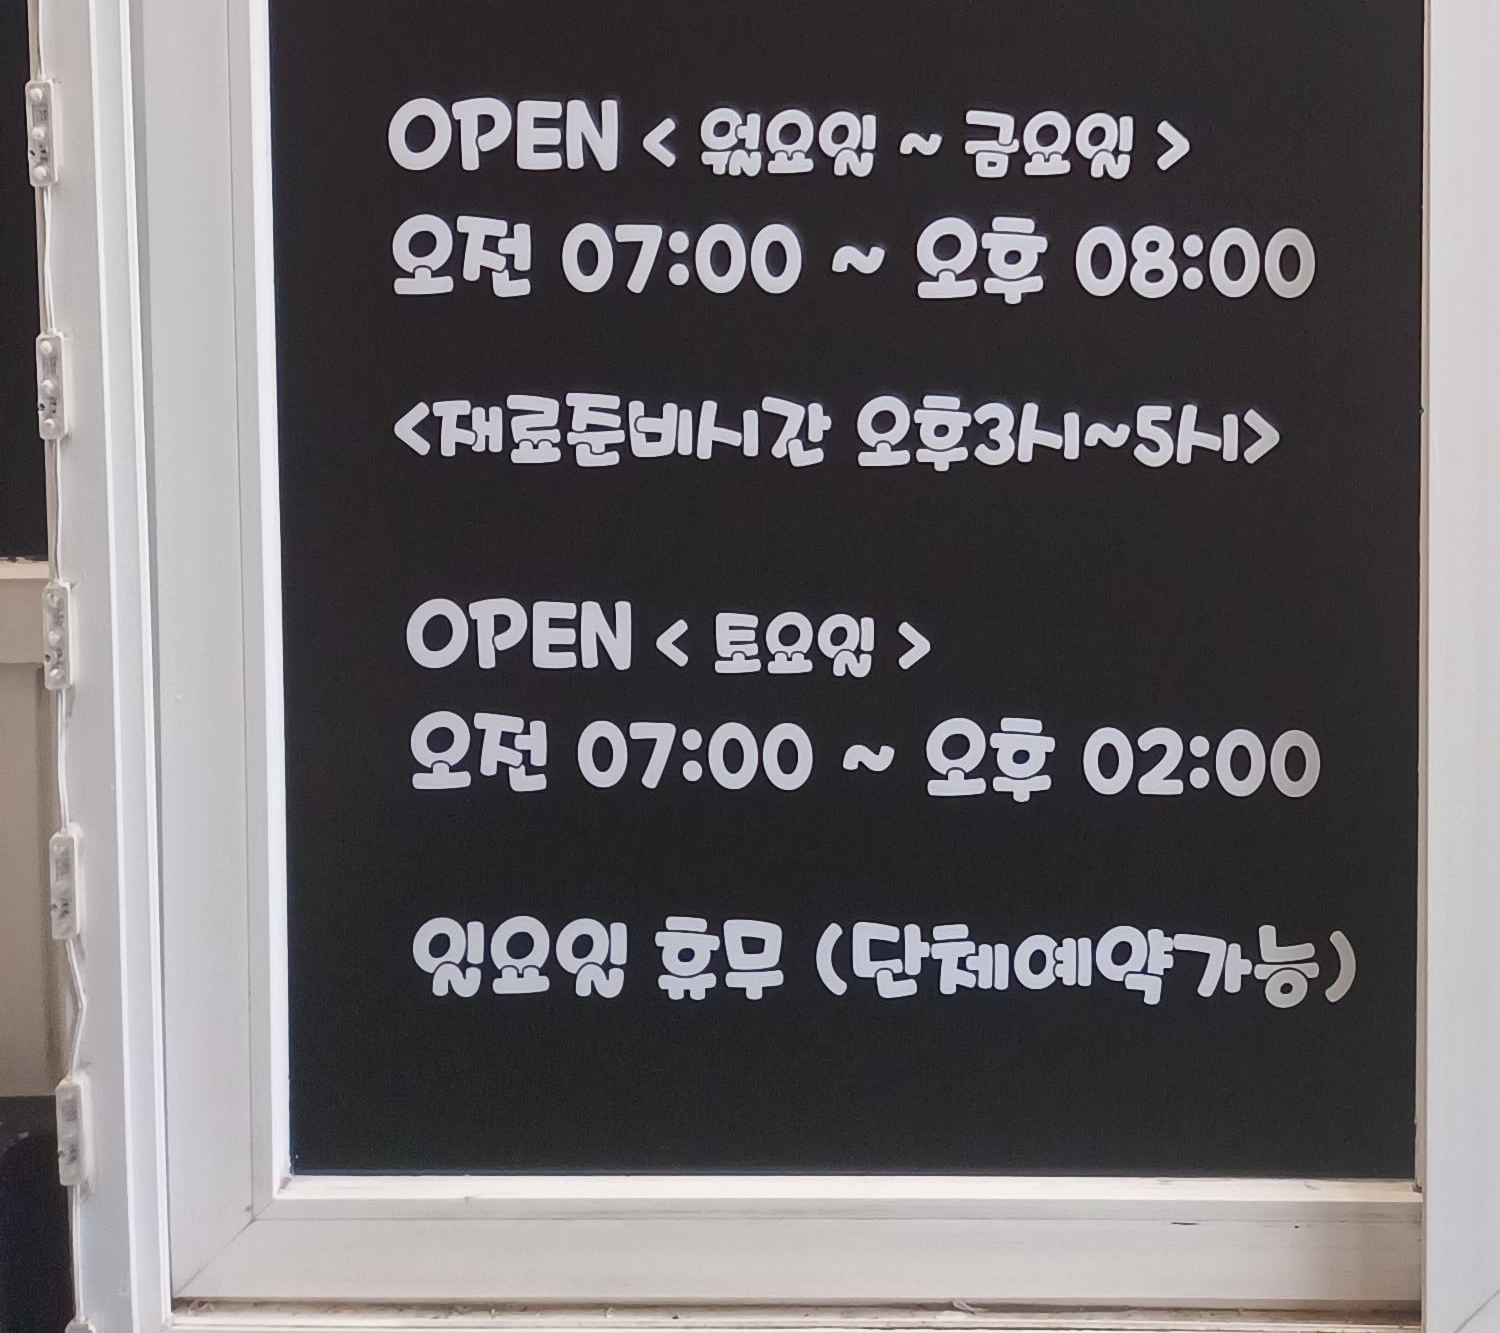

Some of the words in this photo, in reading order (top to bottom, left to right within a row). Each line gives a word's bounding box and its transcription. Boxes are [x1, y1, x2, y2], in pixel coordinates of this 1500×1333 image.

[388, 97, 620, 171] OPEN
[701, 108, 877, 177] 월요일
[965, 110, 1134, 179] 금요일
[393, 214, 532, 297] 오전
[562, 223, 802, 294] 07:00
[917, 217, 1048, 304] 오후
[1076, 225, 1316, 299] 08:00
[406, 598, 632, 670] OPEN
[715, 612, 875, 678] 토요일
[411, 711, 548, 792] 오전
[578, 721, 814, 791] 07:00
[926, 718, 1055, 802] 오후
[1083, 727, 1321, 798] 02:00
[413, 916, 628, 998] 일요일
[655, 916, 785, 1000] 휴무
